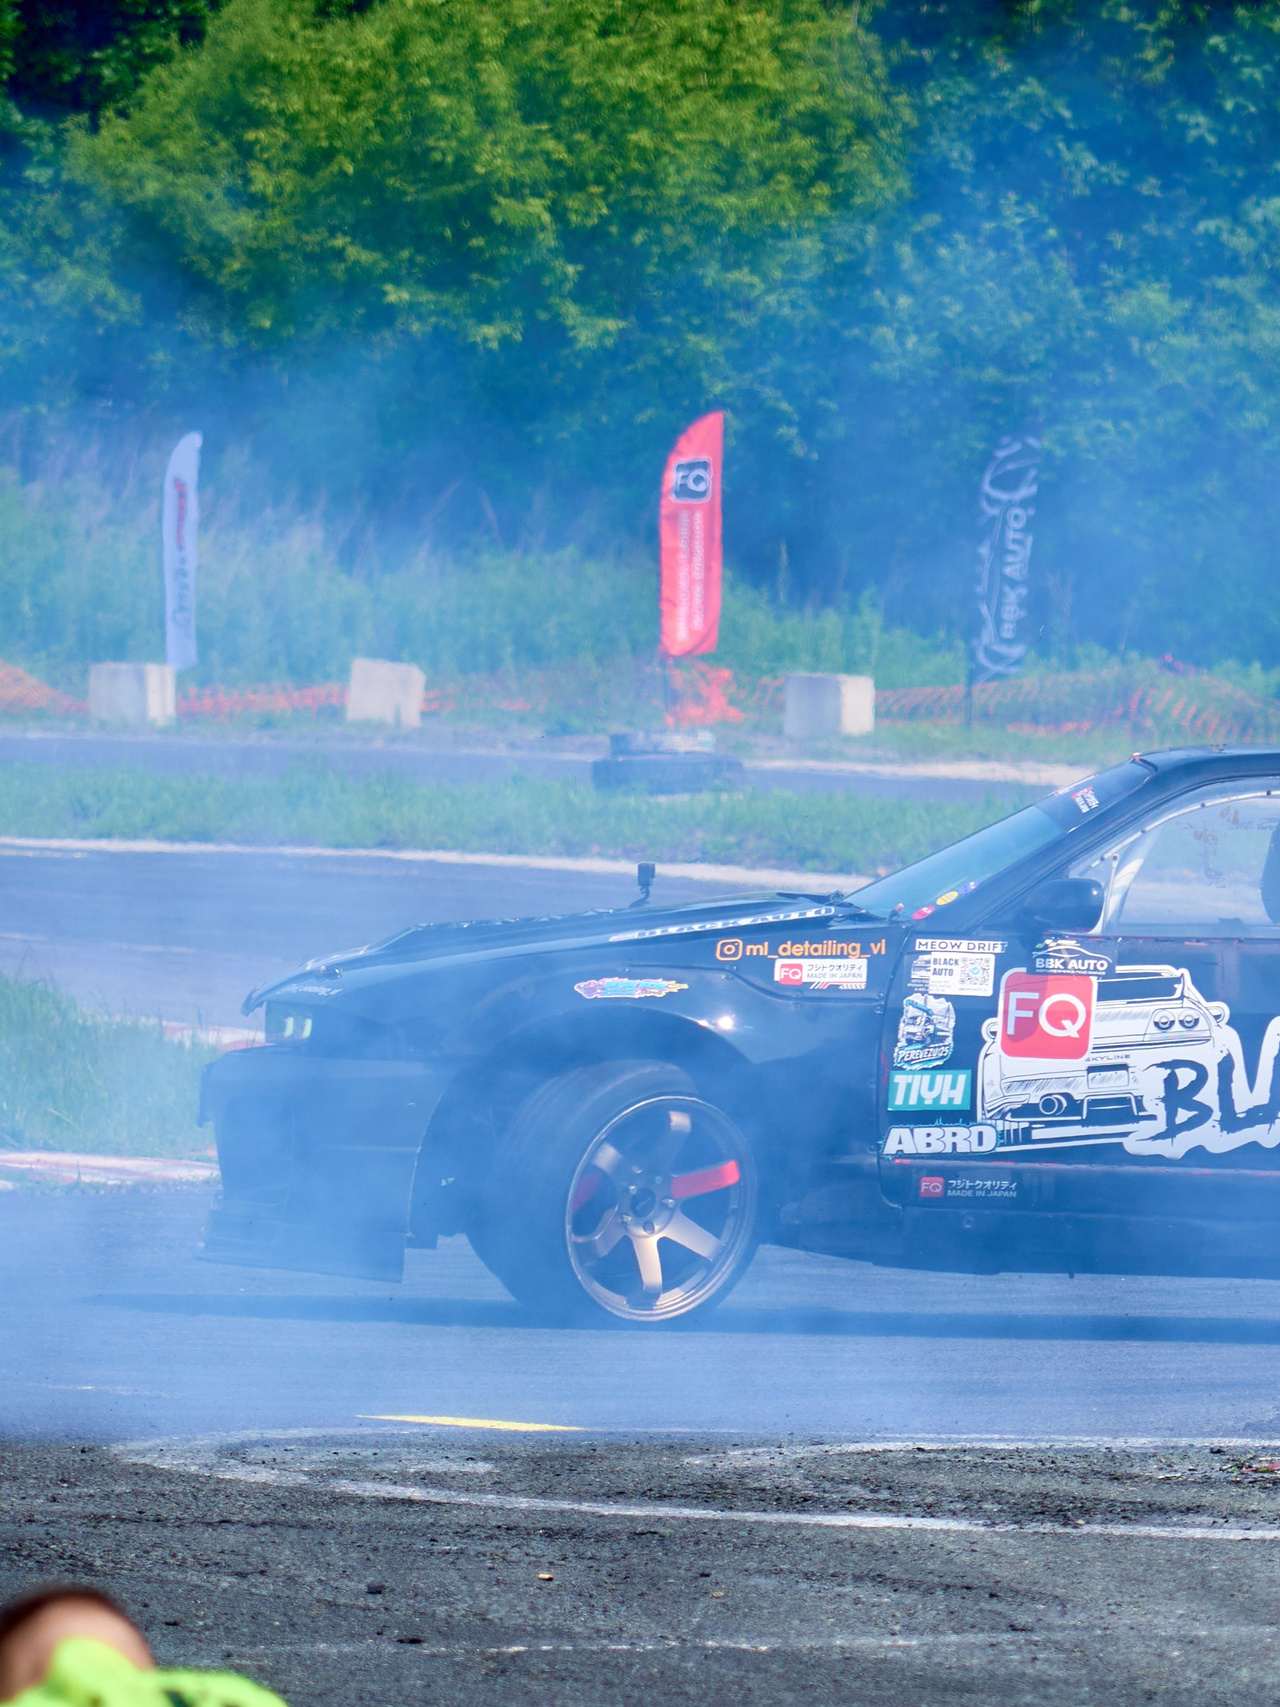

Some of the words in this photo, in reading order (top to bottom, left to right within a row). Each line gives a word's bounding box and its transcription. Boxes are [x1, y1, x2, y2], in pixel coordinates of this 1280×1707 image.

[677, 468, 707, 491] FQ
[1003, 506, 1027, 581] AUTO
[746, 939, 886, 959] ml_detailing_vl
[918, 941, 962, 950] MEOW
[967, 942, 1007, 952] DRIFT
[932, 958, 959, 966] BLACK
[1036, 958, 1065, 969] BBK
[1067, 959, 1108, 971] AUTO
[781, 968, 801, 979] FQ
[932, 968, 953, 976] AUTO
[1006, 992, 1086, 1038] FQ
[883, 1126, 997, 1154] ABRO
[921, 1182, 942, 1193] FQ
